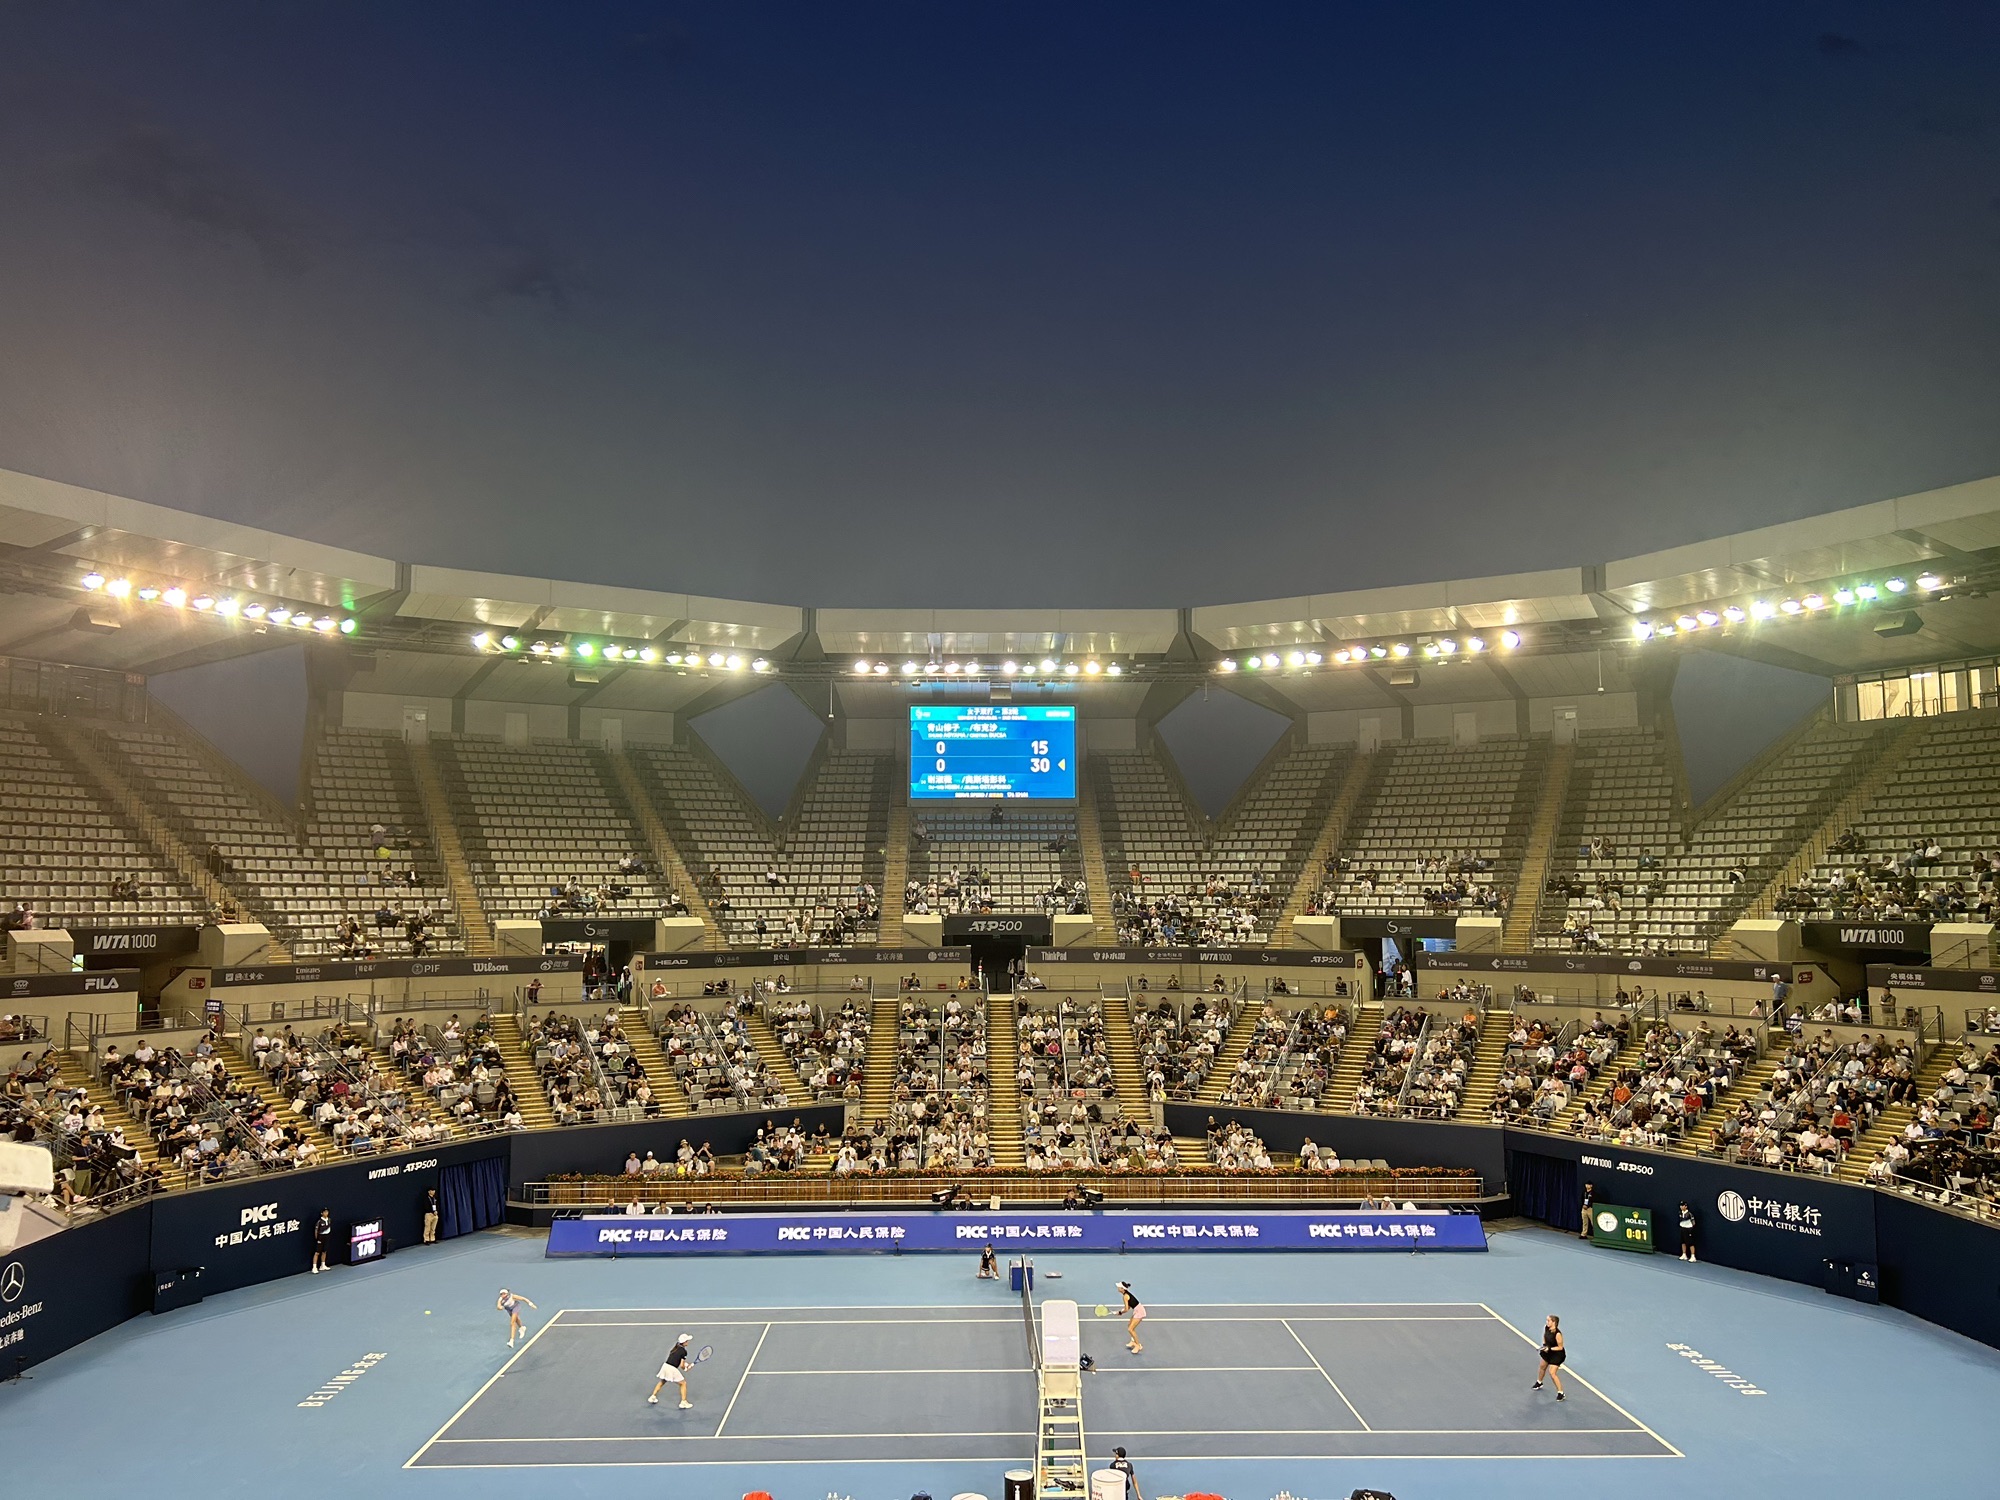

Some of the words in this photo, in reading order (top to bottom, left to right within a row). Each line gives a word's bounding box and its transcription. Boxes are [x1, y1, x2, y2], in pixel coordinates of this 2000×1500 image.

[936, 741, 945, 755] 0
[1031, 740, 1049, 755] 15
[936, 758, 945, 772] 0
[1030, 757, 1050, 773] 30
[93, 935, 130, 949] WTA
[131, 934, 157, 948] 1000
[1841, 929, 1876, 943] WTA
[1877, 929, 1904, 944] 1000
[875, 952, 904, 961] 北京奔驰
[1041, 951, 1067, 961] ThinkPad
[1218, 953, 1232, 961] 1000
[424, 964, 441, 973] PIF
[473, 962, 509, 972] Wilson
[85, 977, 120, 991] FILA
[1581, 1155, 1599, 1166] WTA
[1598, 1158, 1612, 1169] 1000
[368, 1168, 387, 1180] WTA
[386, 1166, 400, 1177] 1000
[241, 1202, 278, 1226] PICC
[1747, 1195, 1822, 1226] 中信银行
[1625, 1218, 1648, 1226] ROLEX
[1749, 1216, 1774, 1228] CHINA
[1776, 1221, 1797, 1232] CITIC
[1799, 1225, 1822, 1236] BANK
[215, 1218, 301, 1249] 中国人民保险
[599, 1229, 632, 1242] PICC
[634, 1228, 728, 1241] 中国人民保险
[778, 1226, 811, 1240] PICC
[813, 1226, 906, 1239] 中国人民保险
[956, 1225, 988, 1238] PICC
[990, 1225, 1083, 1238] 中国人民保险
[1132, 1225, 1165, 1238] PICC
[1167, 1225, 1259, 1238] 中国人民保险
[1308, 1224, 1342, 1237] PICC
[1343, 1224, 1436, 1237] 中国人民保险
[1626, 1227, 1647, 1241] 0:01
[0, 1301, 43, 1328] edes-Benz
[1690, 1358, 1768, 1395] BEIJING
[297, 1369, 366, 1407] BEIJING
